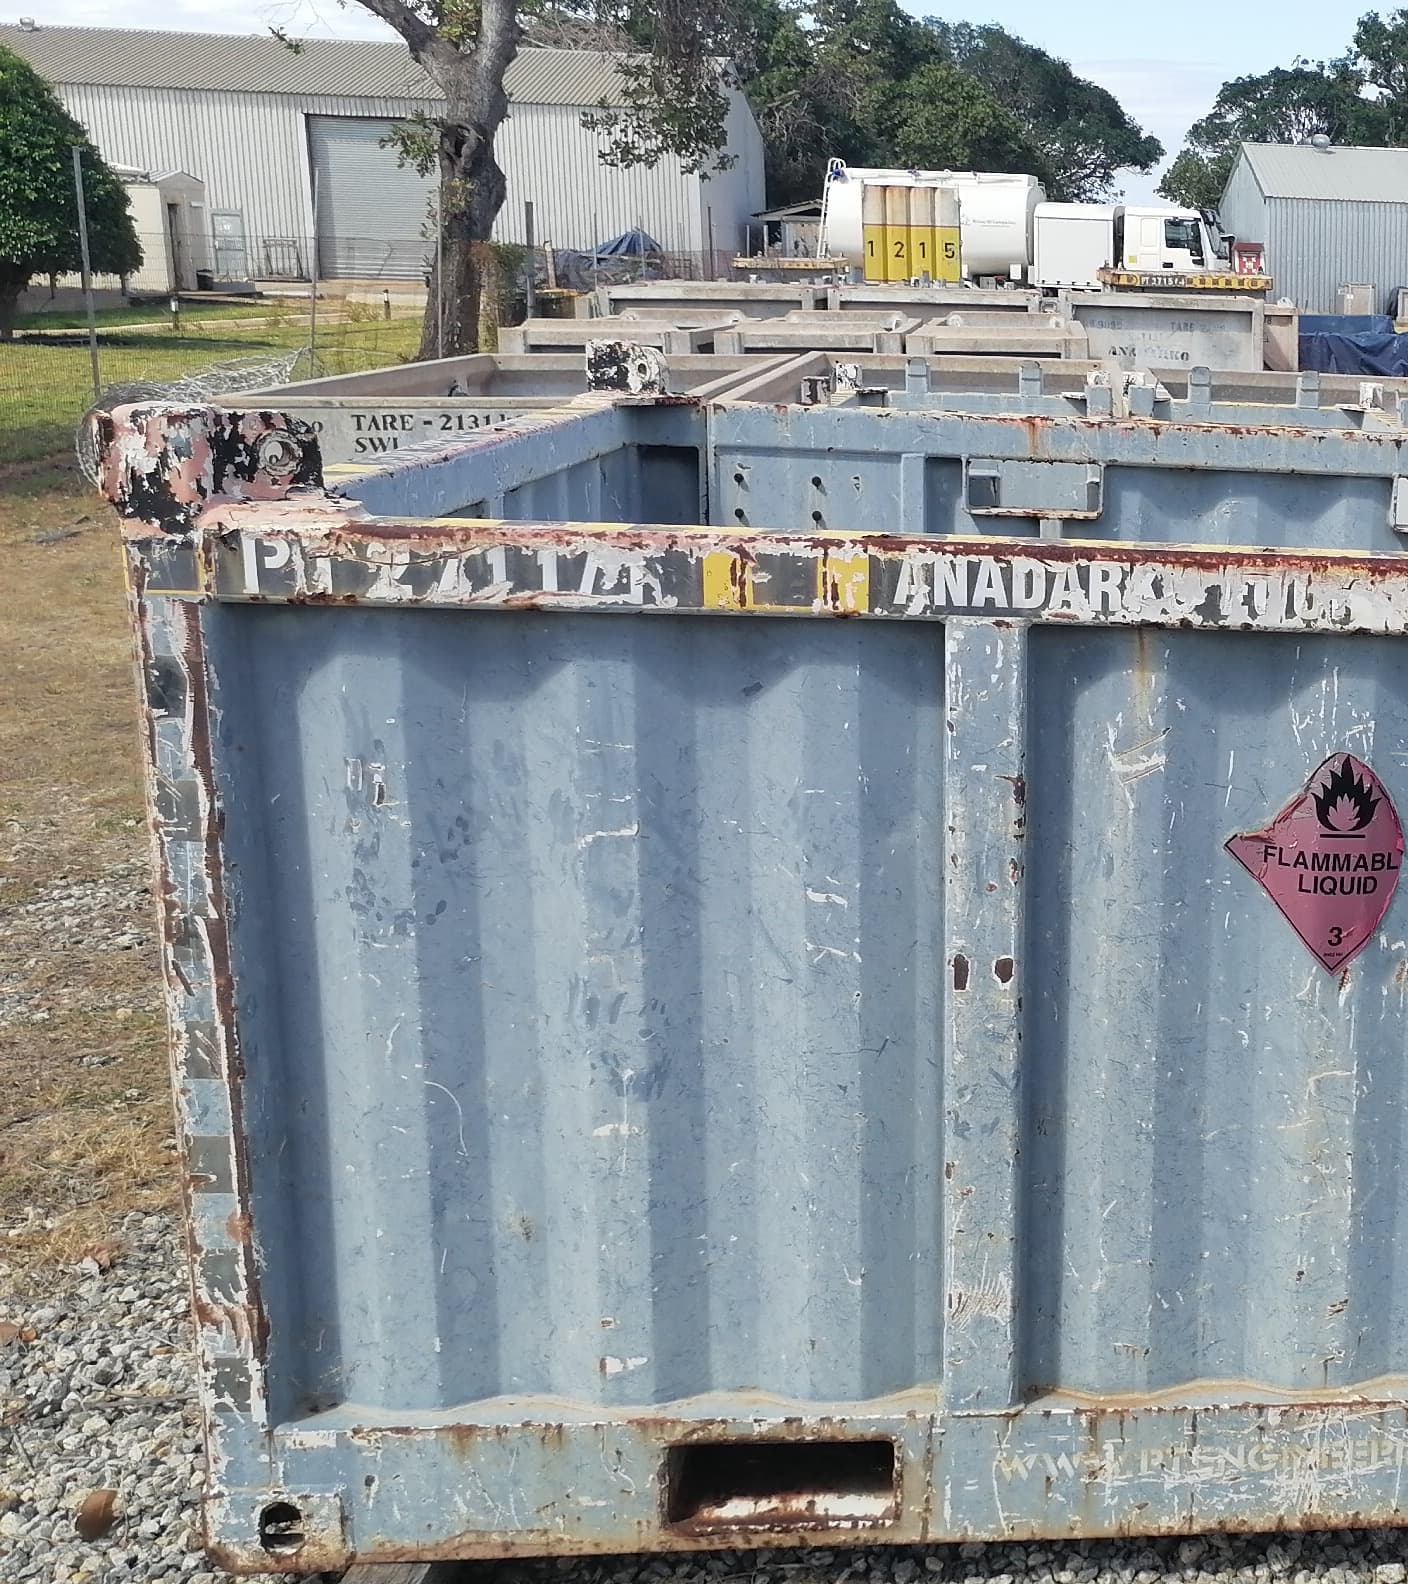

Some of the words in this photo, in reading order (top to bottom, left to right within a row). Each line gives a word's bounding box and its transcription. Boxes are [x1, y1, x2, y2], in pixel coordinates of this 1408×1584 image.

[352, 414, 414, 431] TARE
[1297, 873, 1379, 896] LIQUID
[1327, 926, 1343, 947] 3
